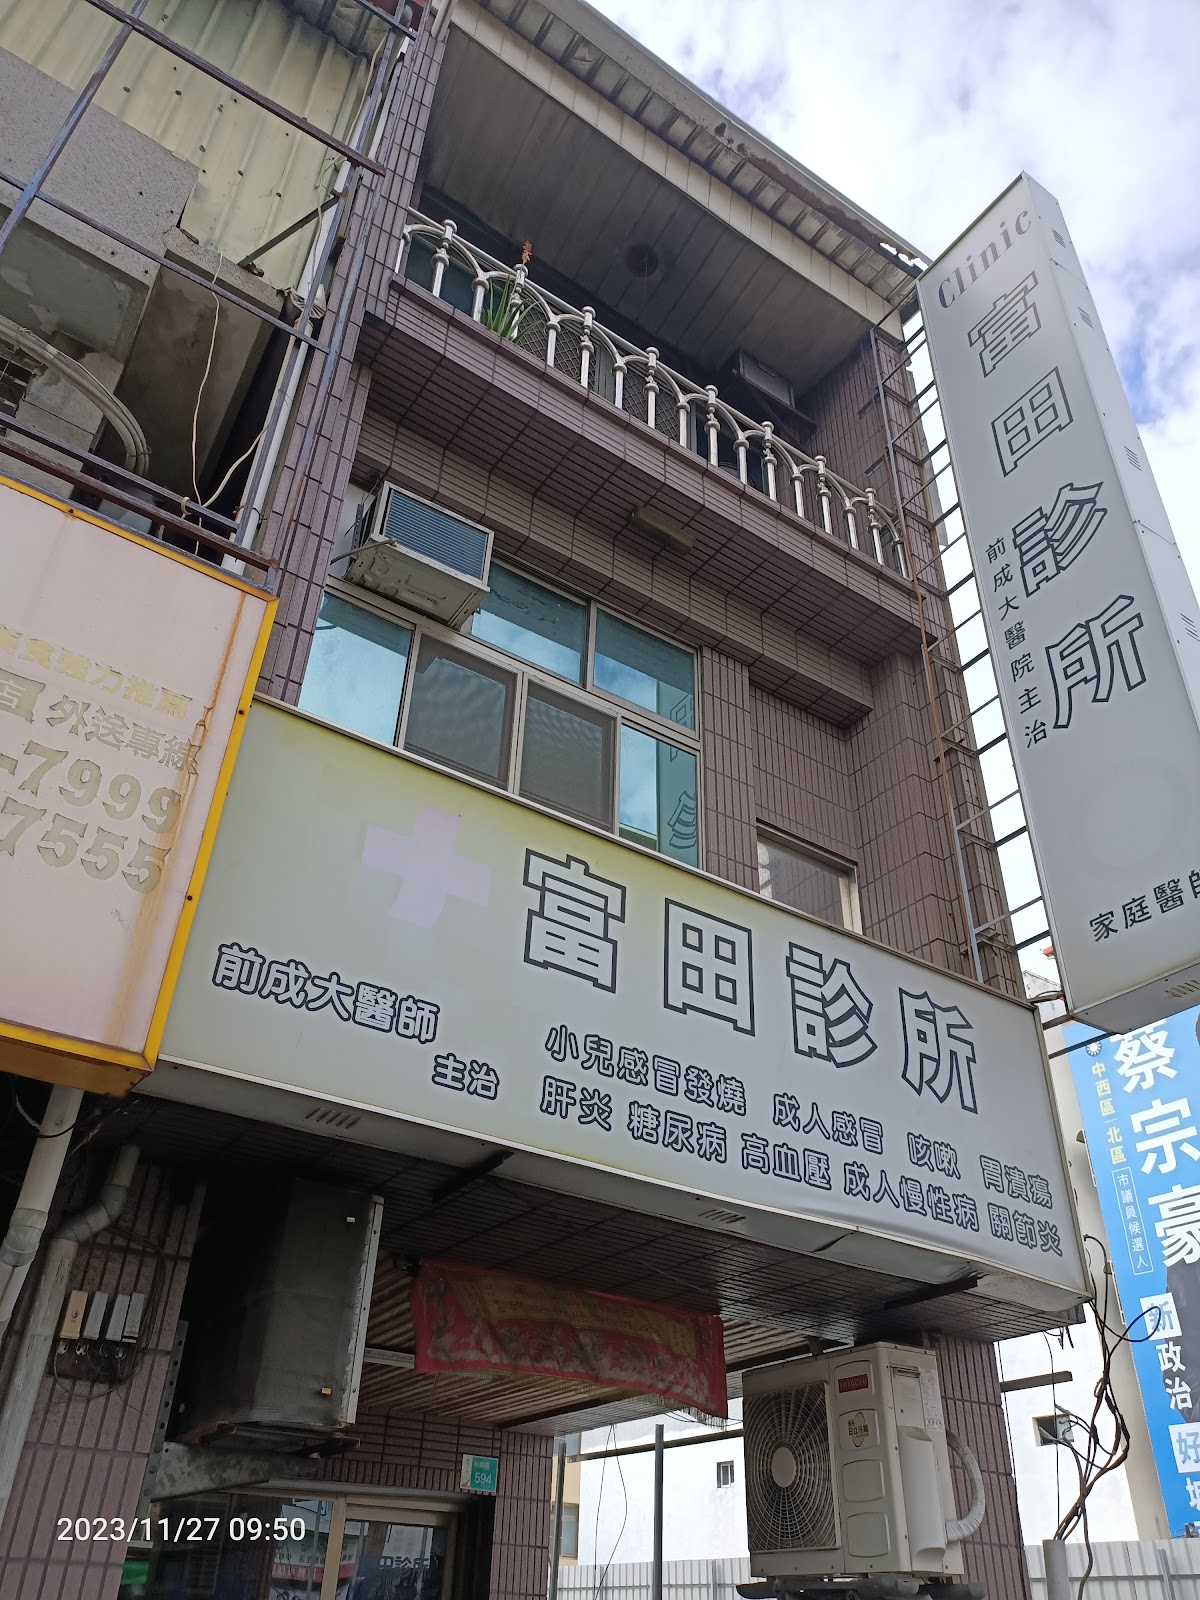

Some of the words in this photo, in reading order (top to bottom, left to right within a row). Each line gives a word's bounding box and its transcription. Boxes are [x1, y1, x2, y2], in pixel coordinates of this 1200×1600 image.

[938, 210, 1032, 309] Clinic
[967, 271, 1147, 729] 富田診所
[985, 537, 1047, 748] 前成大醫院主治
[46, 695, 202, 776] 外送專線
[212, 942, 440, 1044] 前成大醫師
[522, 847, 978, 1114] 富田診所
[432, 1053, 500, 1100] 主治
[545, 1024, 747, 1117] 小兒感冒發燒
[772, 1093, 884, 1155] 成人感冒
[907, 1133, 961, 1180] 咳嗽
[979, 1155, 1054, 1209] 胃潰瘍
[540, 1075, 612, 1132] 肝炎
[628, 1102, 728, 1163] 糖尿病
[741, 1133, 832, 1190] 高血壓
[843, 1162, 980, 1232] 成人慢性病
[988, 1204, 1063, 1257] 關節炎
[1117, 1173, 1149, 1270] 市議員候選人
[839, 1377, 867, 1391] HITACHI
[474, 1472, 492, 1485] 594
